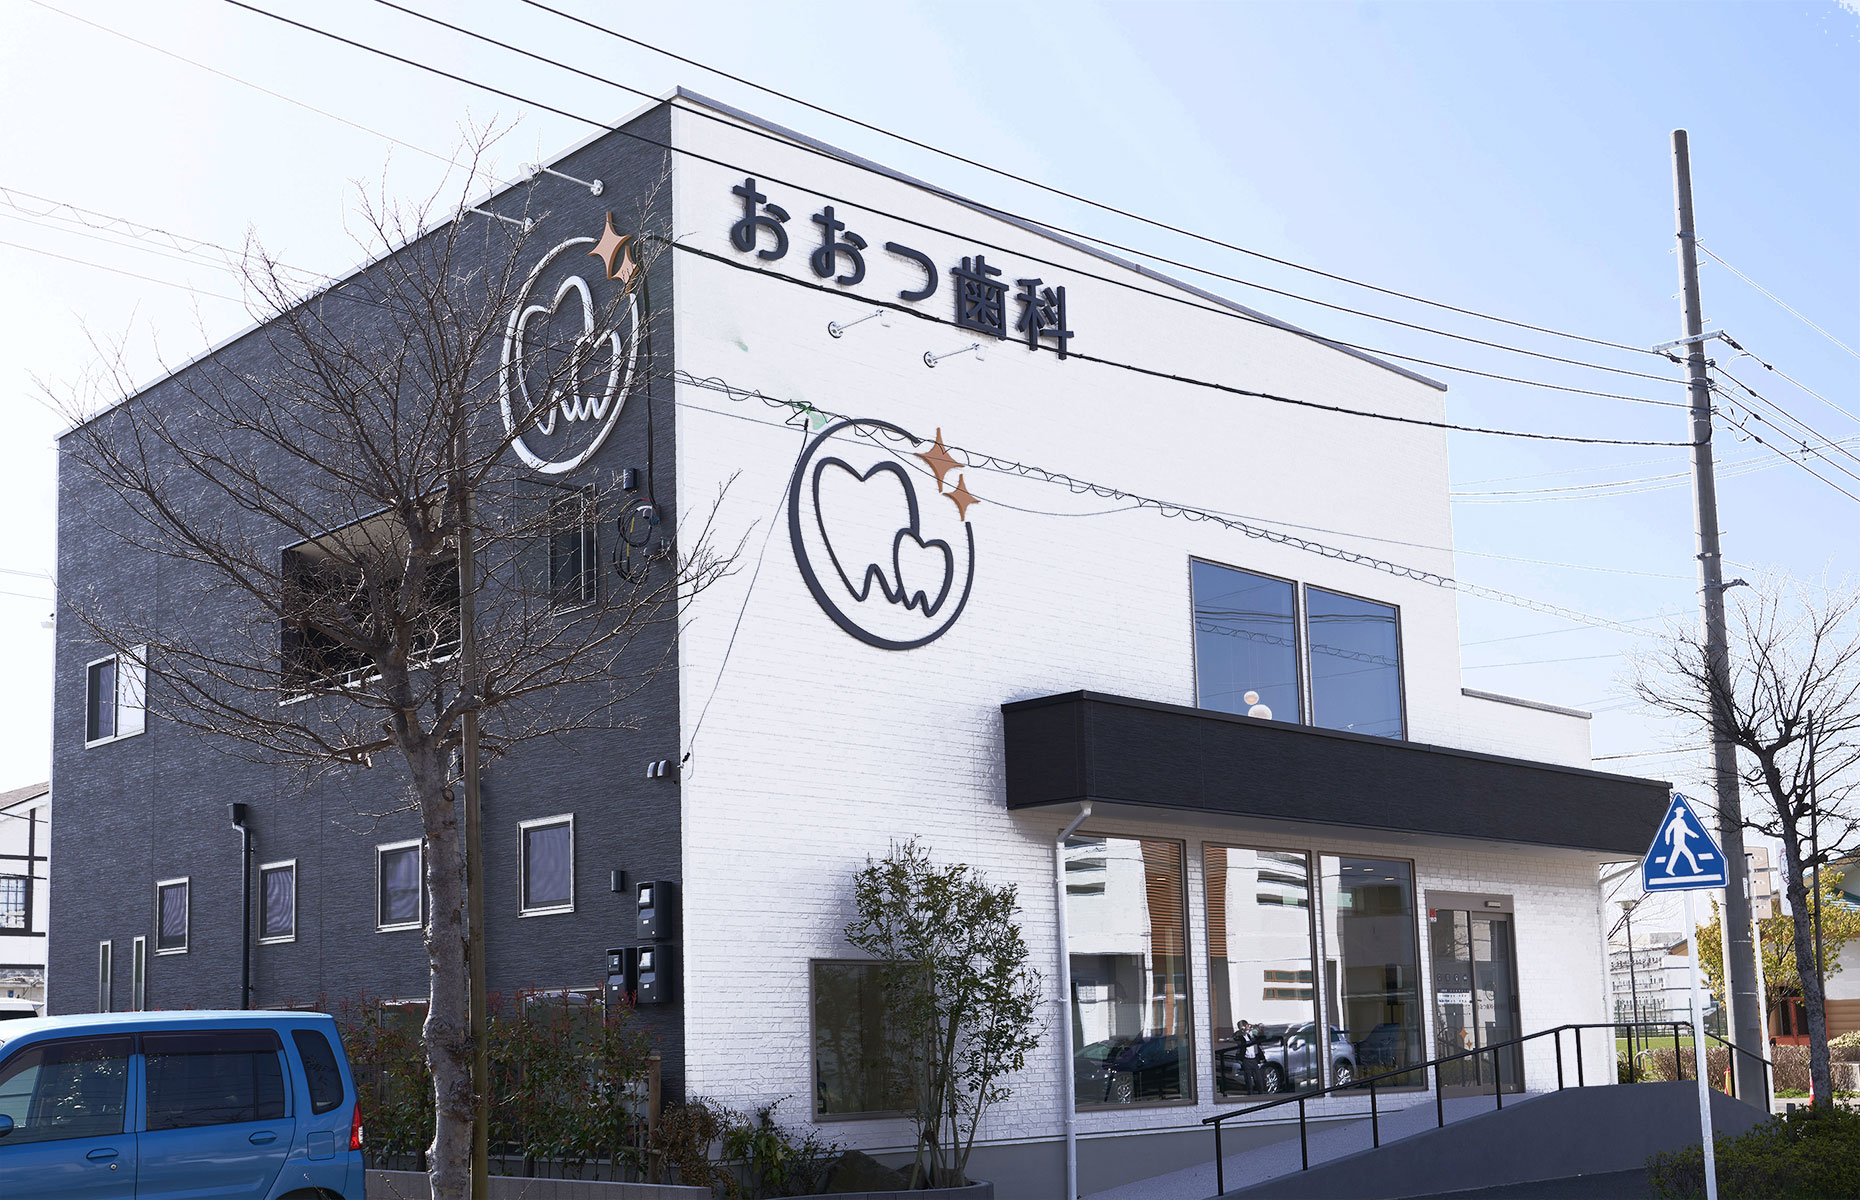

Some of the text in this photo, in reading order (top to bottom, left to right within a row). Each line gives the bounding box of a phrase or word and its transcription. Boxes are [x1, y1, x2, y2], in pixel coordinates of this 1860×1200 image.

[731, 177, 1074, 360] おおつ歯科
